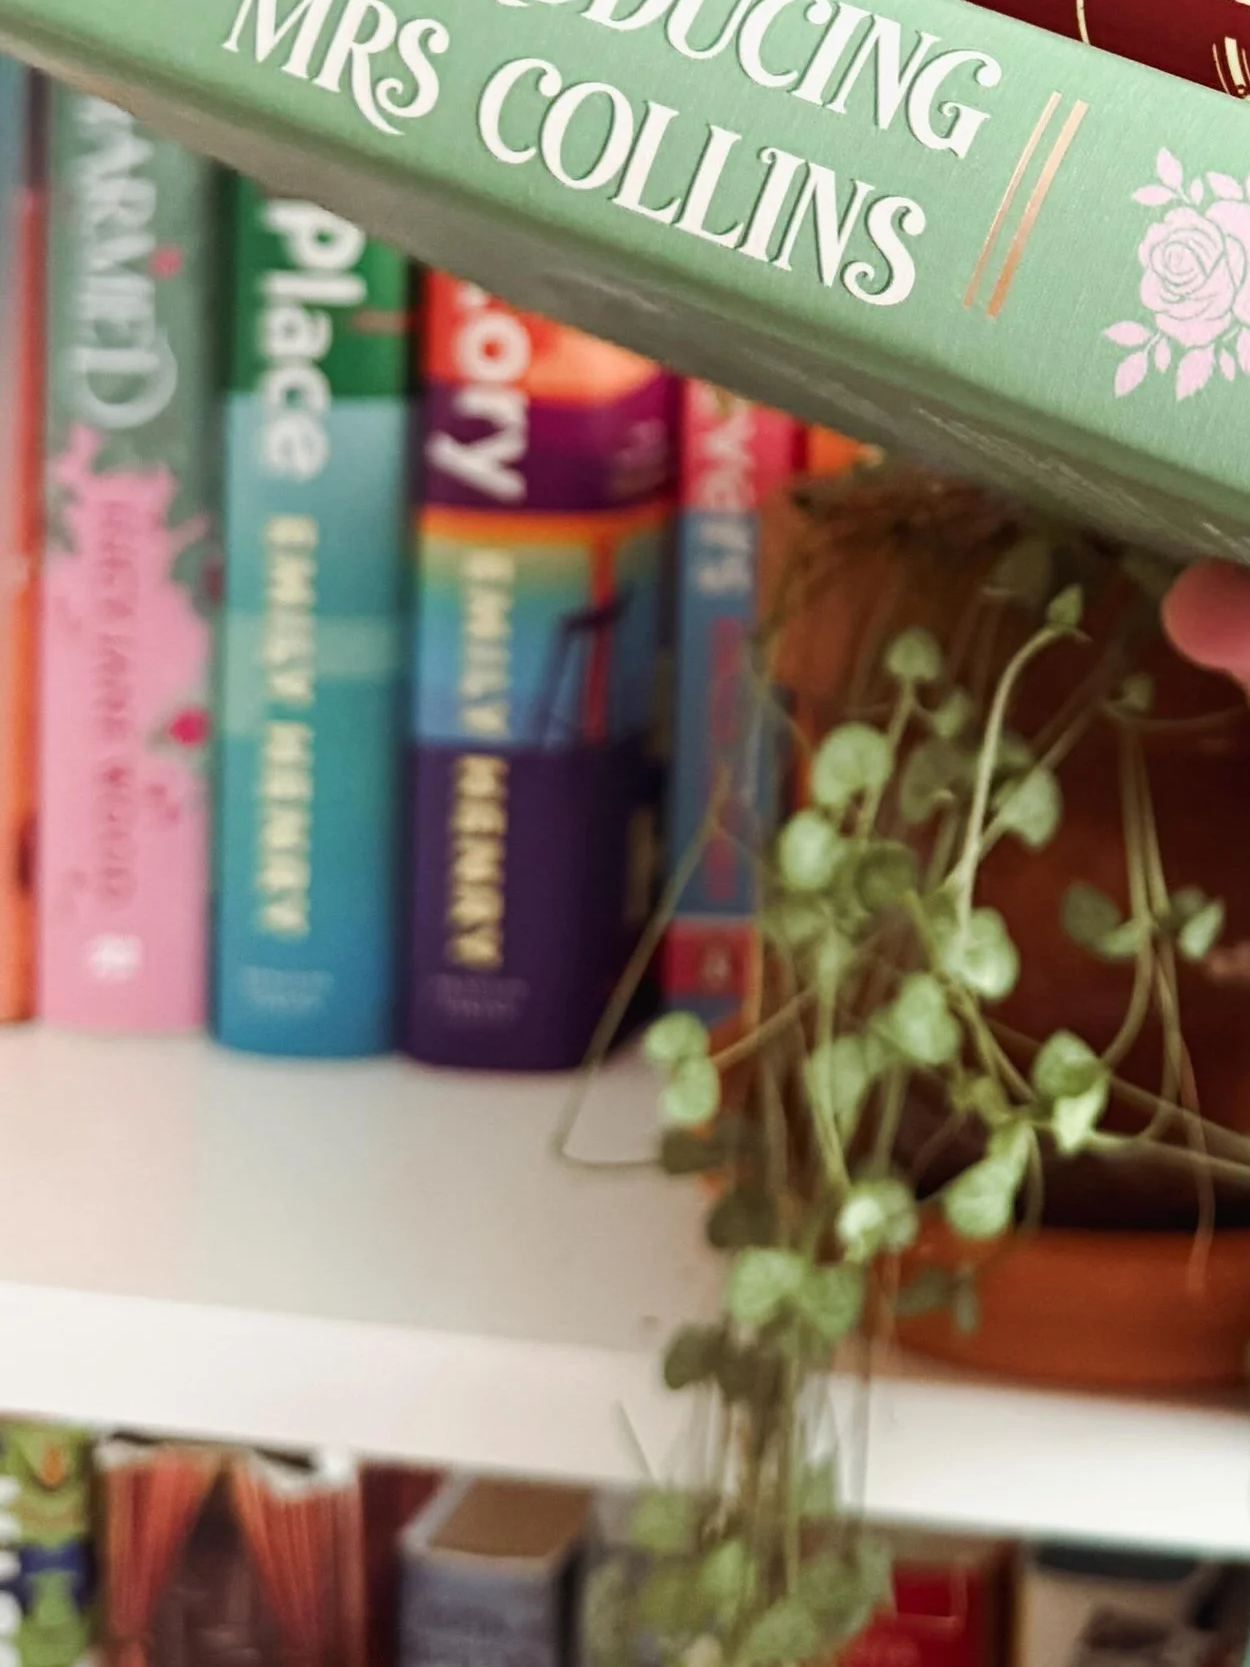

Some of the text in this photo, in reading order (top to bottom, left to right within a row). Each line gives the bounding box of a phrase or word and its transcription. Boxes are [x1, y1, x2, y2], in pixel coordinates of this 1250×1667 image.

[478, 58, 928, 311] COLLINS
[259, 201, 367, 482] Place
[427, 281, 533, 503] ory
[447, 754, 509, 969] HENRY
